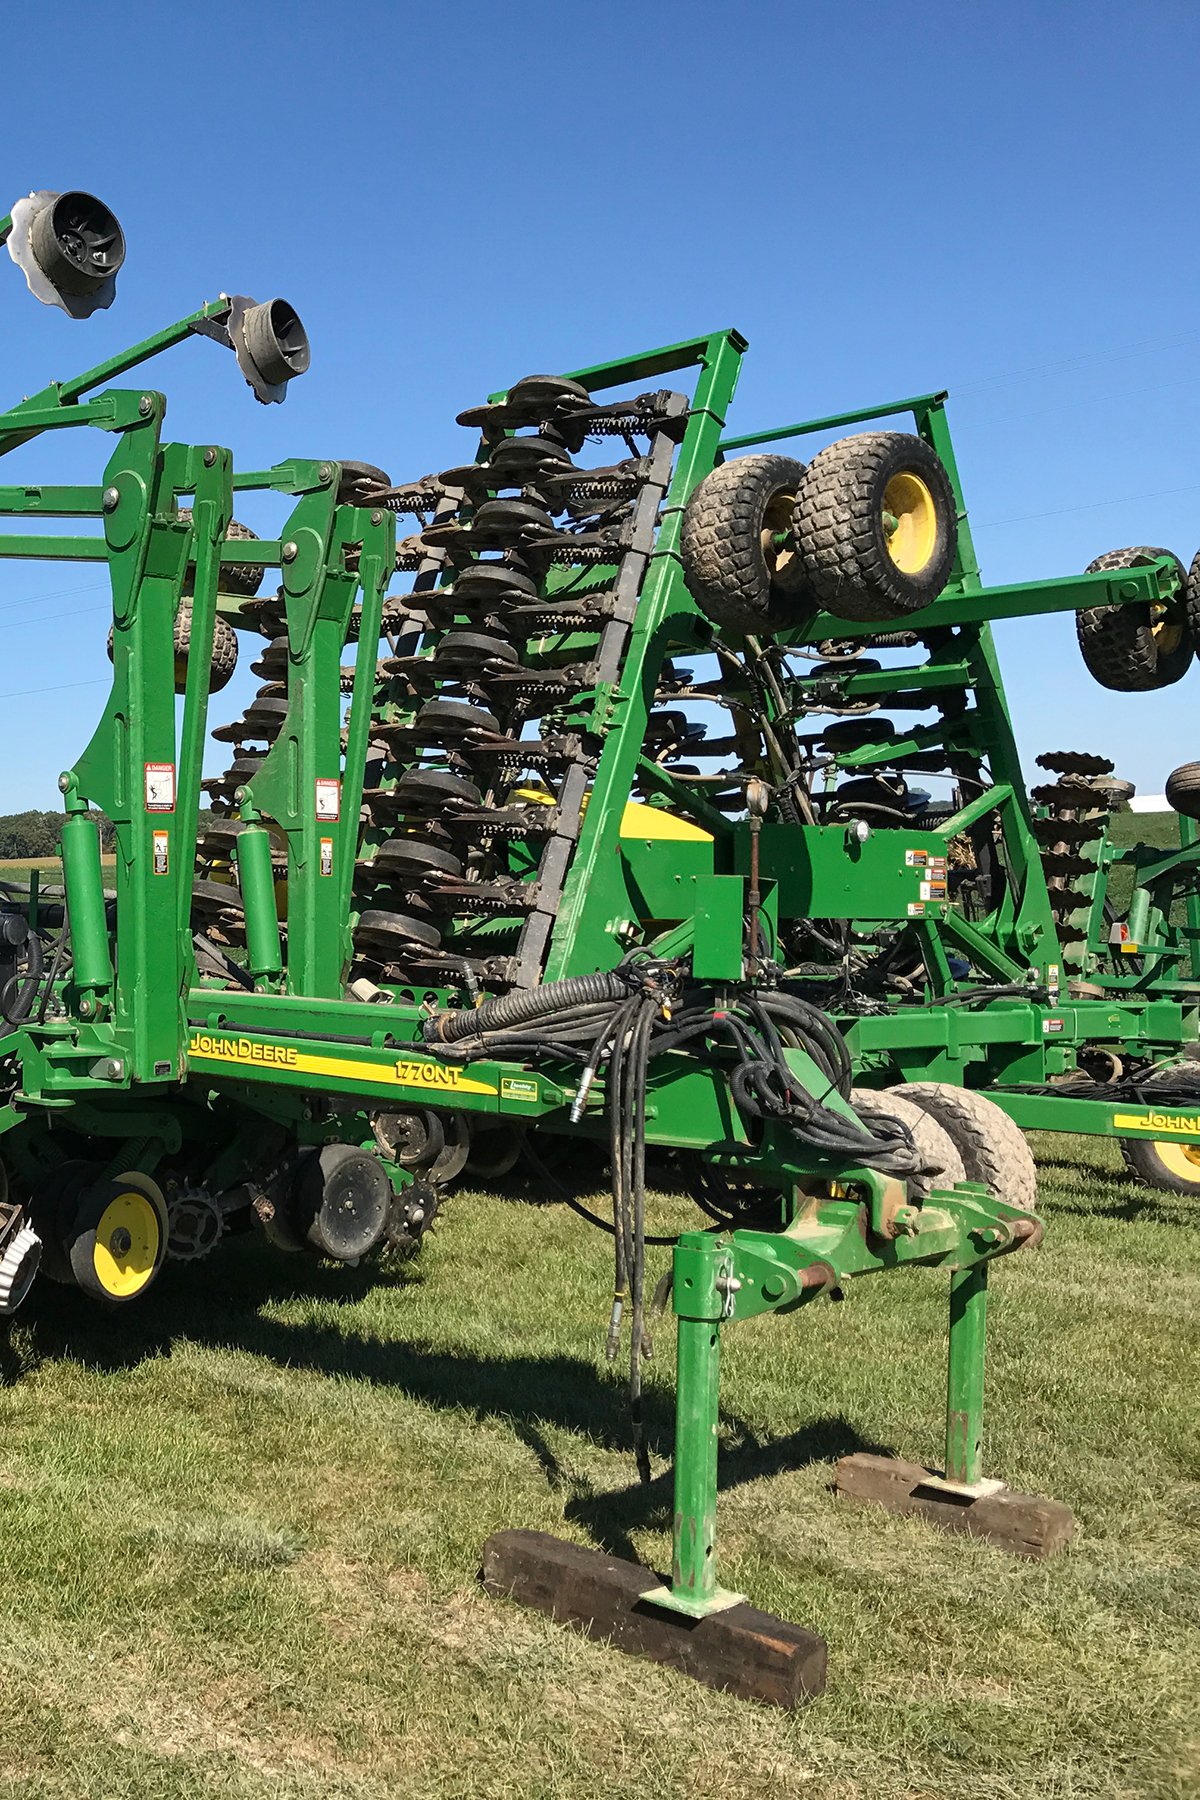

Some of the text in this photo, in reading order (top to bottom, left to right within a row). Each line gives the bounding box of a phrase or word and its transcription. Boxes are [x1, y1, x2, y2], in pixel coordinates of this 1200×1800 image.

[190, 1032, 298, 1064] JOHN DEERE
[395, 1060, 463, 1084] 1770NT
[1141, 1111, 1195, 1130] JOHN
